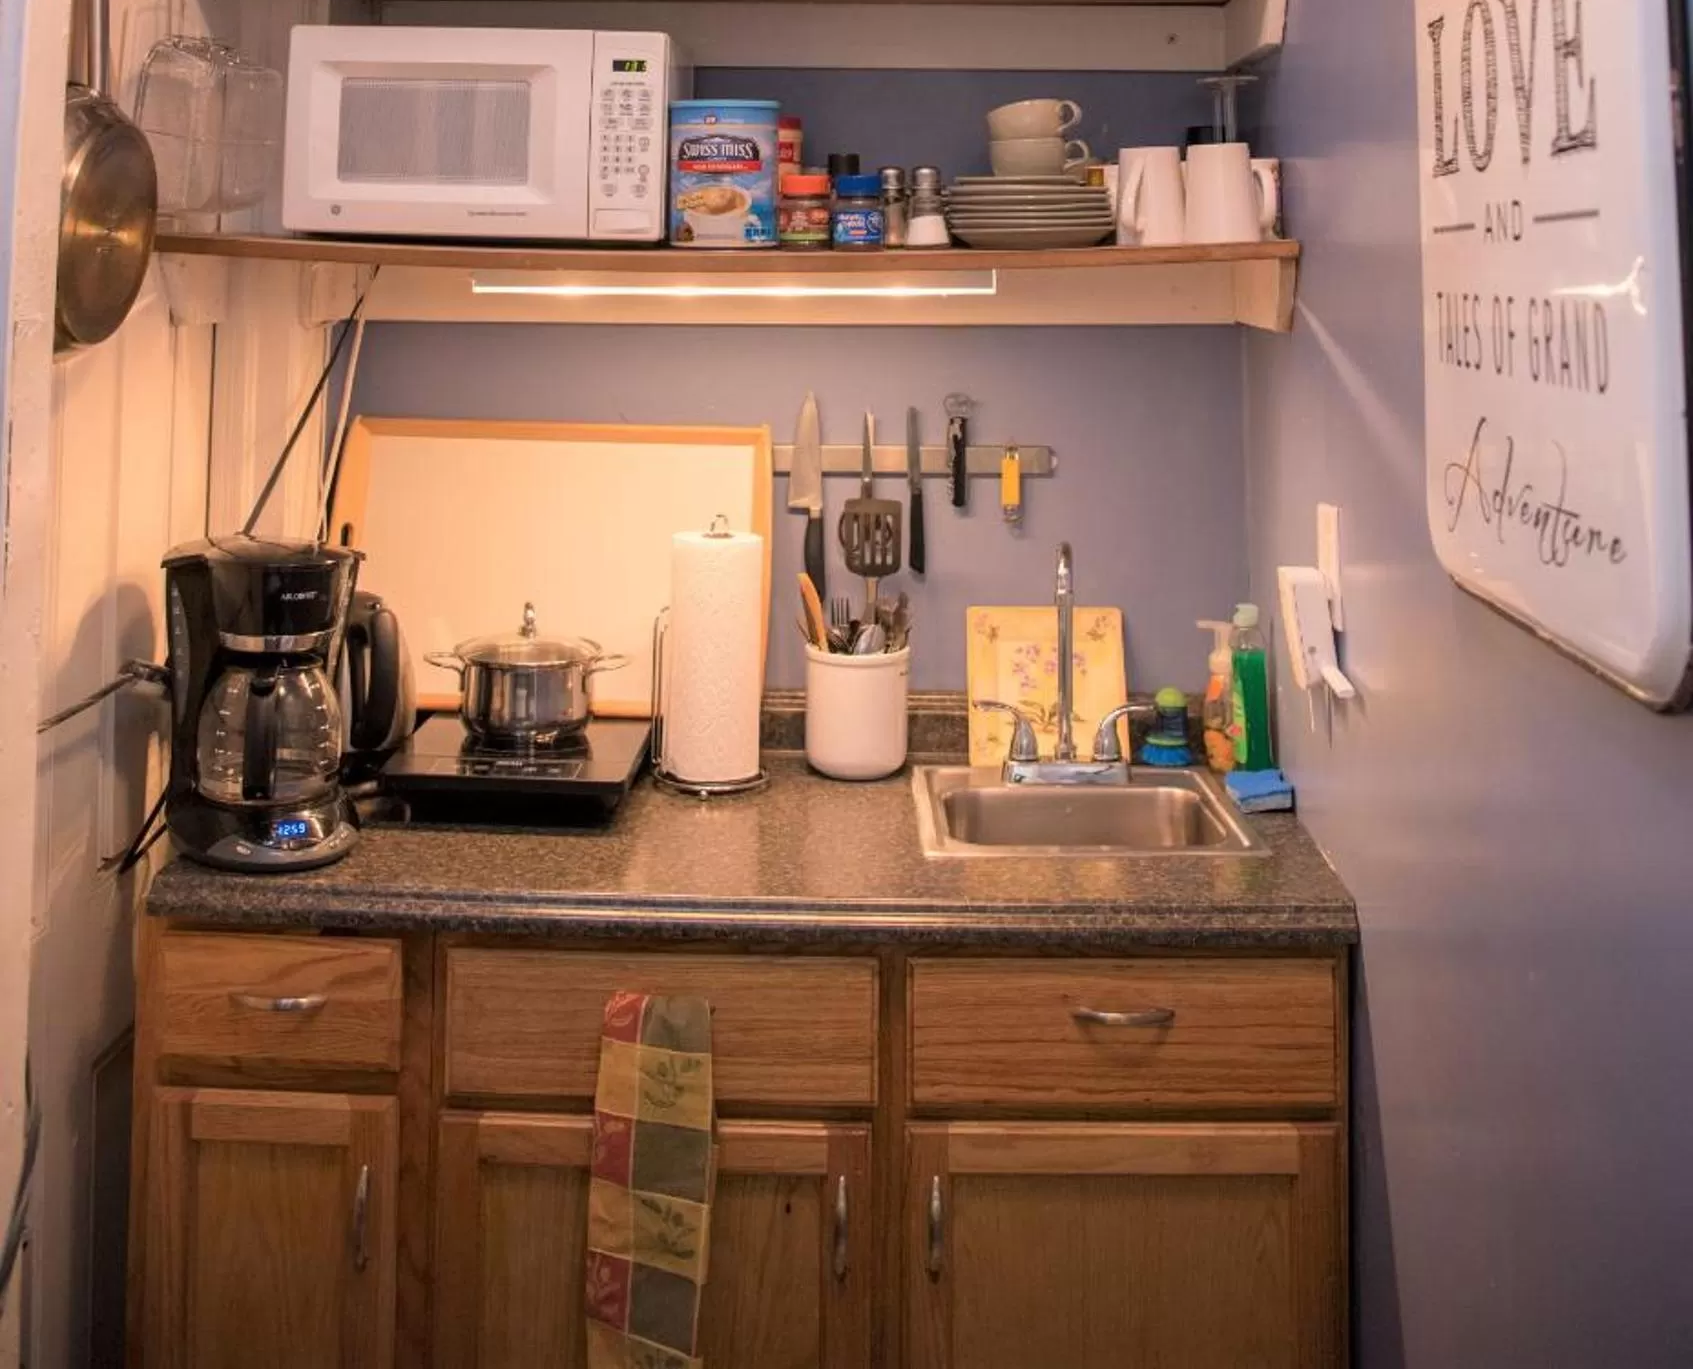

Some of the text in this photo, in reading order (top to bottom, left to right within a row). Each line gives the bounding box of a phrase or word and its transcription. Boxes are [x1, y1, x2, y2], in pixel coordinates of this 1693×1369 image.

[1484, 199, 1523, 244] AND
[1436, 291, 1609, 395] TALES OF GRAND
[1444, 416, 1627, 568] Adventure
